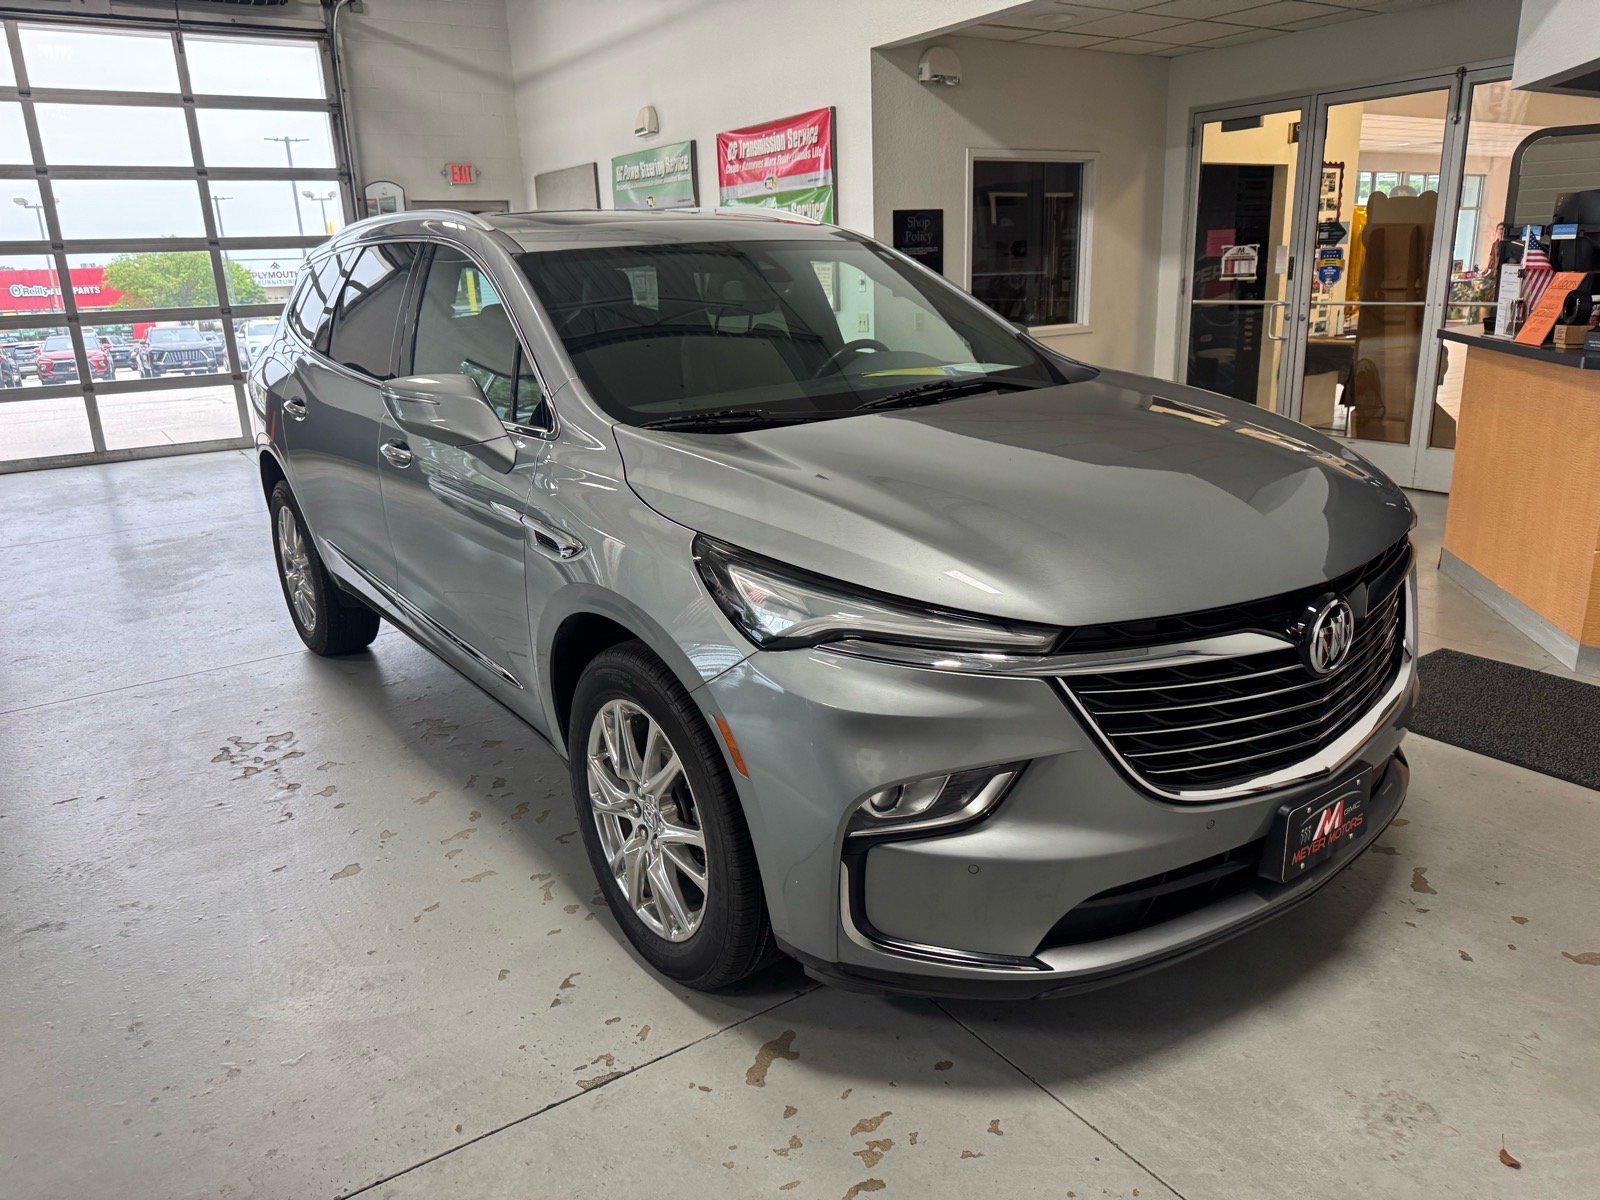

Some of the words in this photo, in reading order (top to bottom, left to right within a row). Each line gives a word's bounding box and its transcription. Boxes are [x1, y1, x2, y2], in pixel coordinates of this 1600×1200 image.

[738, 131, 787, 160] Transmission
[787, 123, 819, 150] Service
[450, 164, 473, 183] EXIT
[623, 164, 640, 181] Power
[640, 158, 666, 179] Steering
[665, 153, 690, 175] Service
[790, 200, 825, 223] Service
[907, 216, 930, 230] Shop
[904, 231, 933, 245] Policy
[10, 284, 49, 297] O'Reilly
[72, 286, 101, 295] PARTS
[1292, 837, 1326, 865] MEYER
[1328, 813, 1364, 845] MOTORS
